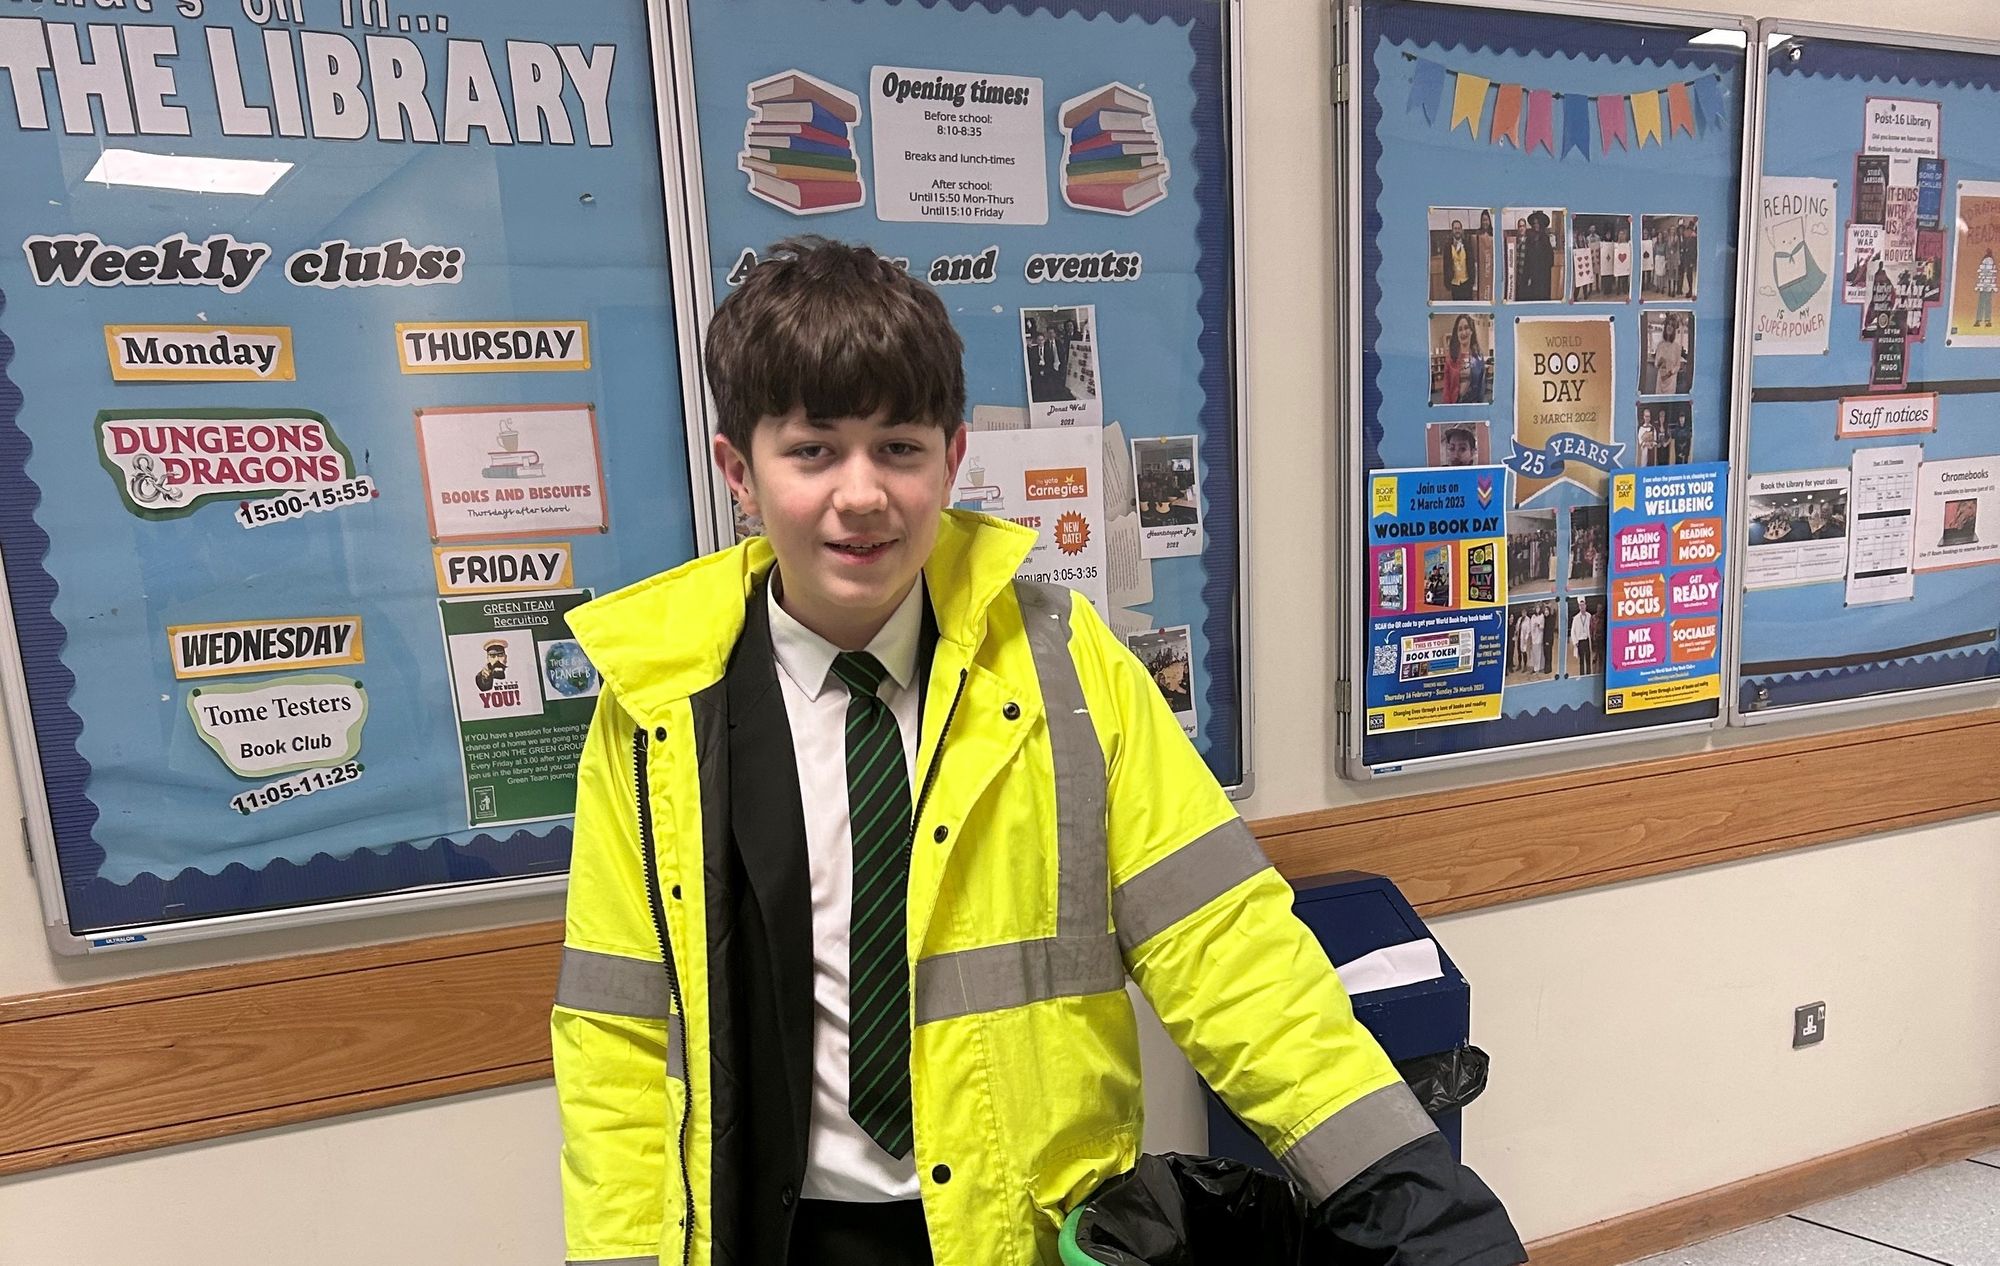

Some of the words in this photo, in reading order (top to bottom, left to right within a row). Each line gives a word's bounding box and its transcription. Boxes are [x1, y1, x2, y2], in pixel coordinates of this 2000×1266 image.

[0, 18, 191, 137] THE
[205, 25, 616, 147] LIBRARY
[883, 72, 967, 107] Opening
[970, 80, 1030, 106] times:
[924, 111, 956, 122] Before
[959, 113, 992, 124] school:
[1875, 113, 1904, 124] Post-16
[1907, 115, 1931, 129] Library
[937, 125, 982, 137] 8:10-8:35
[904, 151, 937, 162] Breaks
[939, 154, 958, 163] and
[960, 154, 1015, 165] lunch-times
[932, 179, 956, 189] After
[958, 181, 992, 190] school:
[963, 194, 1014, 204] Mon-Thurs
[1888, 187, 1896, 199] IT
[1897, 188, 1918, 201] ENDS
[974, 208, 1004, 219] Friday
[1764, 194, 1828, 219] READING
[1853, 230, 1878, 238] WORLD
[1858, 238, 1873, 246] WAR
[29, 238, 267, 287] Weekly
[290, 241, 461, 283] clubs:
[930, 250, 996, 282] and
[1026, 252, 1139, 280] events:
[1777, 309, 1785, 320] IS
[1800, 307, 1810, 318] MY
[1758, 313, 1825, 337] SUPERPOWER
[405, 330, 575, 362] THURSDAY
[1545, 336, 1581, 348] WORLD
[122, 335, 276, 373] Monday
[1534, 352, 1596, 375] BOOK
[1543, 380, 1585, 402] DAY
[1533, 415, 1538, 424] 3
[1540, 413, 1573, 424] MARCH
[1575, 412, 1597, 422] 2022
[1850, 407, 1884, 429] Staff
[1885, 406, 1928, 423] notices
[108, 425, 324, 454] DUNGEONS
[1520, 451, 1546, 474] 25
[1551, 438, 1609, 464] YEARS
[160, 455, 341, 485] DRAGONS
[1941, 469, 1989, 482] Chromebooks
[1028, 484, 1084, 497] Carnegies
[1416, 482, 1434, 495] Join
[1437, 484, 1446, 493] us
[1449, 484, 1459, 492] on
[1646, 483, 1685, 498] BOOSTS
[1688, 481, 1714, 494] YOUR
[1760, 482, 1774, 490] Book
[441, 490, 490, 504] BOOKS
[496, 488, 524, 501] AND
[529, 484, 592, 500] BISCUITS
[240, 480, 370, 524] 15:00-15:55
[1410, 499, 1416, 510] 2
[1418, 497, 1443, 510] March
[1445, 496, 1465, 508] 2023
[1645, 496, 1713, 516] WELLBEING
[467, 509, 514, 519] Thursdays
[515, 506, 538, 515] after
[541, 505, 570, 513] school
[1063, 522, 1079, 532] NEW
[1375, 521, 1425, 538] WORLD
[1429, 519, 1469, 535] BOOK
[1473, 517, 1499, 532] DAY
[1680, 527, 1714, 540] READING
[1062, 533, 1081, 544] DATE!
[1621, 532, 1660, 545] READING
[1622, 543, 1660, 562] HABIT
[1679, 544, 1715, 560] MOOD
[448, 553, 560, 585] FRIDAY
[1054, 566, 1097, 581] 3:05-3:35
[1690, 575, 1703, 584] GET
[1624, 585, 1653, 599] YOUR
[1673, 582, 1718, 603] READY
[483, 603, 521, 616] GREEN
[524, 600, 555, 611] TEAM
[1618, 597, 1660, 616] FOCUS
[494, 615, 549, 628] Recruiting
[1426, 619, 1435, 627] your
[1436, 617, 1448, 625] World
[1460, 615, 1468, 623] Day
[1629, 628, 1651, 643] MIX
[1673, 625, 1716, 641] SOCIALISE
[181, 624, 351, 669] WEDNESDAY
[1625, 646, 1636, 660] IT
[1638, 644, 1654, 658] UP
[1406, 651, 1429, 662] BOOK
[1432, 648, 1457, 658] TOKEN
[550, 669, 582, 679] PLANET
[585, 667, 591, 678] B
[479, 690, 521, 708] YOU!
[1412, 691, 1432, 699] February
[1436, 688, 1452, 696] Sunday
[204, 704, 268, 727] Tome
[272, 696, 351, 719] Testers
[515, 729, 541, 738] passion
[552, 735, 570, 743] going
[241, 739, 287, 759] Book
[292, 734, 332, 752] Club
[468, 753, 490, 761] THEN
[492, 750, 510, 758] JOIN
[512, 748, 527, 756] THE
[529, 745, 556, 754] GREEN
[492, 760, 513, 768] Friday
[557, 754, 571, 762] your
[469, 773, 480, 781] join
[513, 767, 533, 775] library
[550, 764, 562, 772] you
[550, 772, 576, 781] journey.
[233, 762, 358, 812] 11:05-11:25
